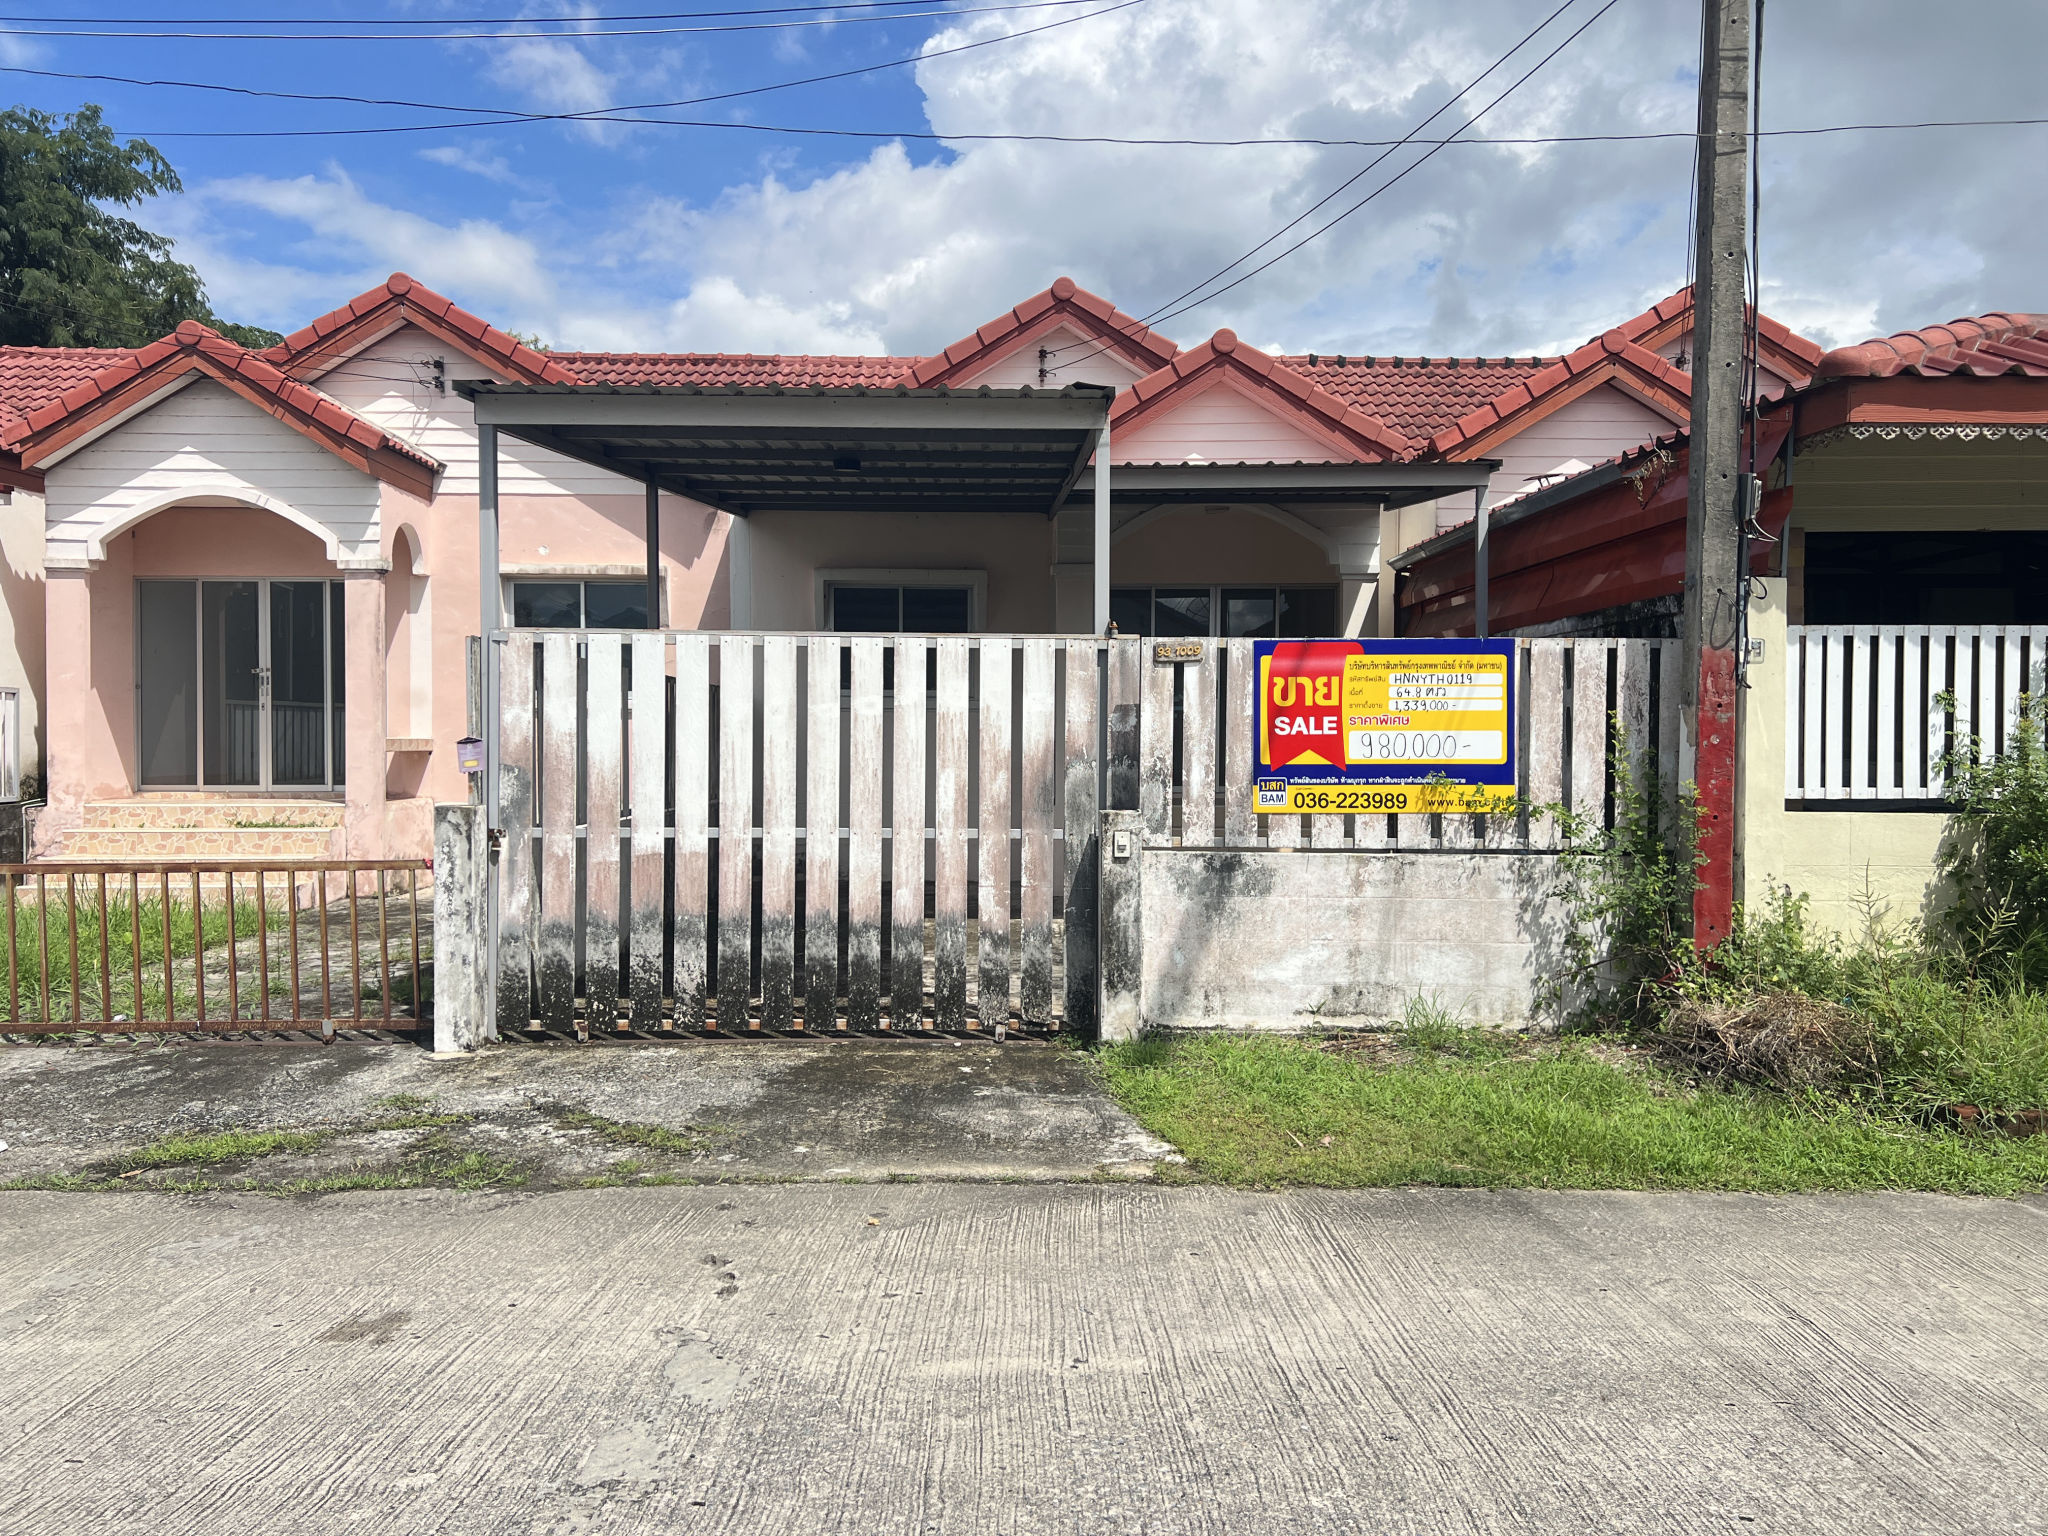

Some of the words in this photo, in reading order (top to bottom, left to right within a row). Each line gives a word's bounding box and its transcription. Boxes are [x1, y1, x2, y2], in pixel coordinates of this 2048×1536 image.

[1157, 647, 1171, 657] 93
[1459, 660, 1475, 670] จำกัด
[1476, 661, 1502, 671] (มหาชน)
[1273, 675, 1339, 707] ขาย
[1274, 716, 1338, 735] SALE
[1349, 714, 1410, 726] ราคาพิเศษ
[1260, 781, 1284, 791] บสก
[1261, 794, 1284, 803] BAM
[1294, 792, 1408, 809] 036-223989
